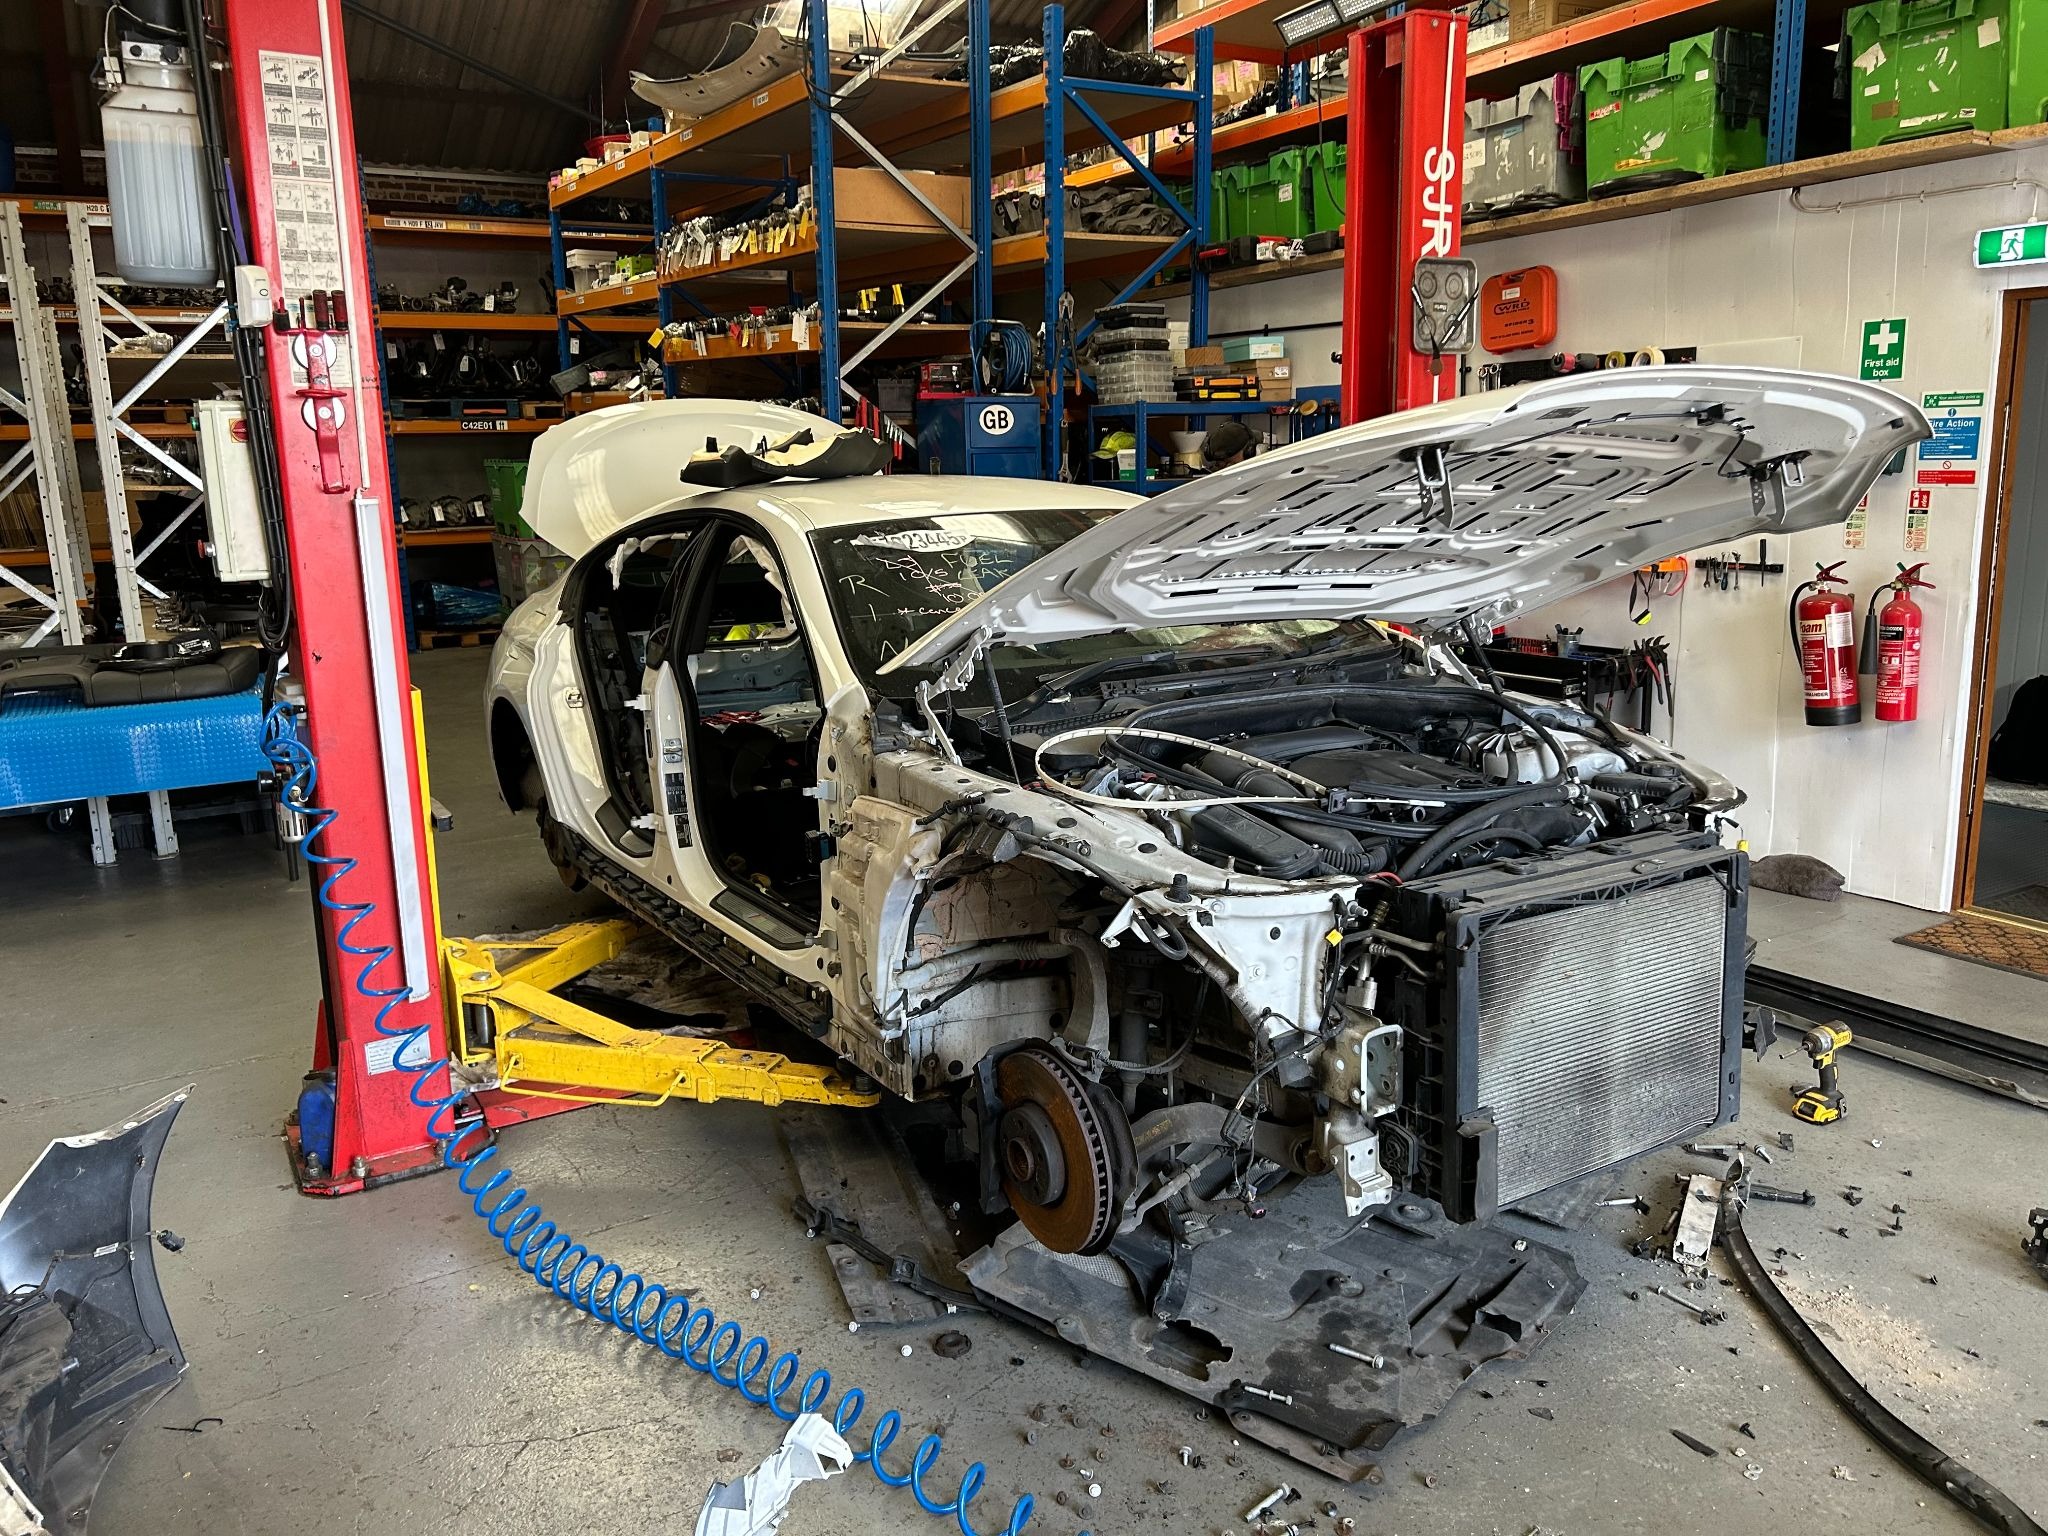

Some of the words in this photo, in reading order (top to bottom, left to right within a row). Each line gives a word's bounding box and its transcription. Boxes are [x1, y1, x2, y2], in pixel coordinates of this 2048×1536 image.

[1421, 146, 1456, 258] SJR
[1498, 301, 1531, 311] WRD
[1864, 359, 1884, 368] First
[1885, 357, 1900, 367] aid
[1872, 369, 1889, 377] box
[462, 421, 493, 430] C42E01
[983, 410, 1009, 430] GB
[1946, 419, 1975, 428] Action
[941, 548, 1013, 569] FUEL
[1800, 623, 1823, 634] oam
